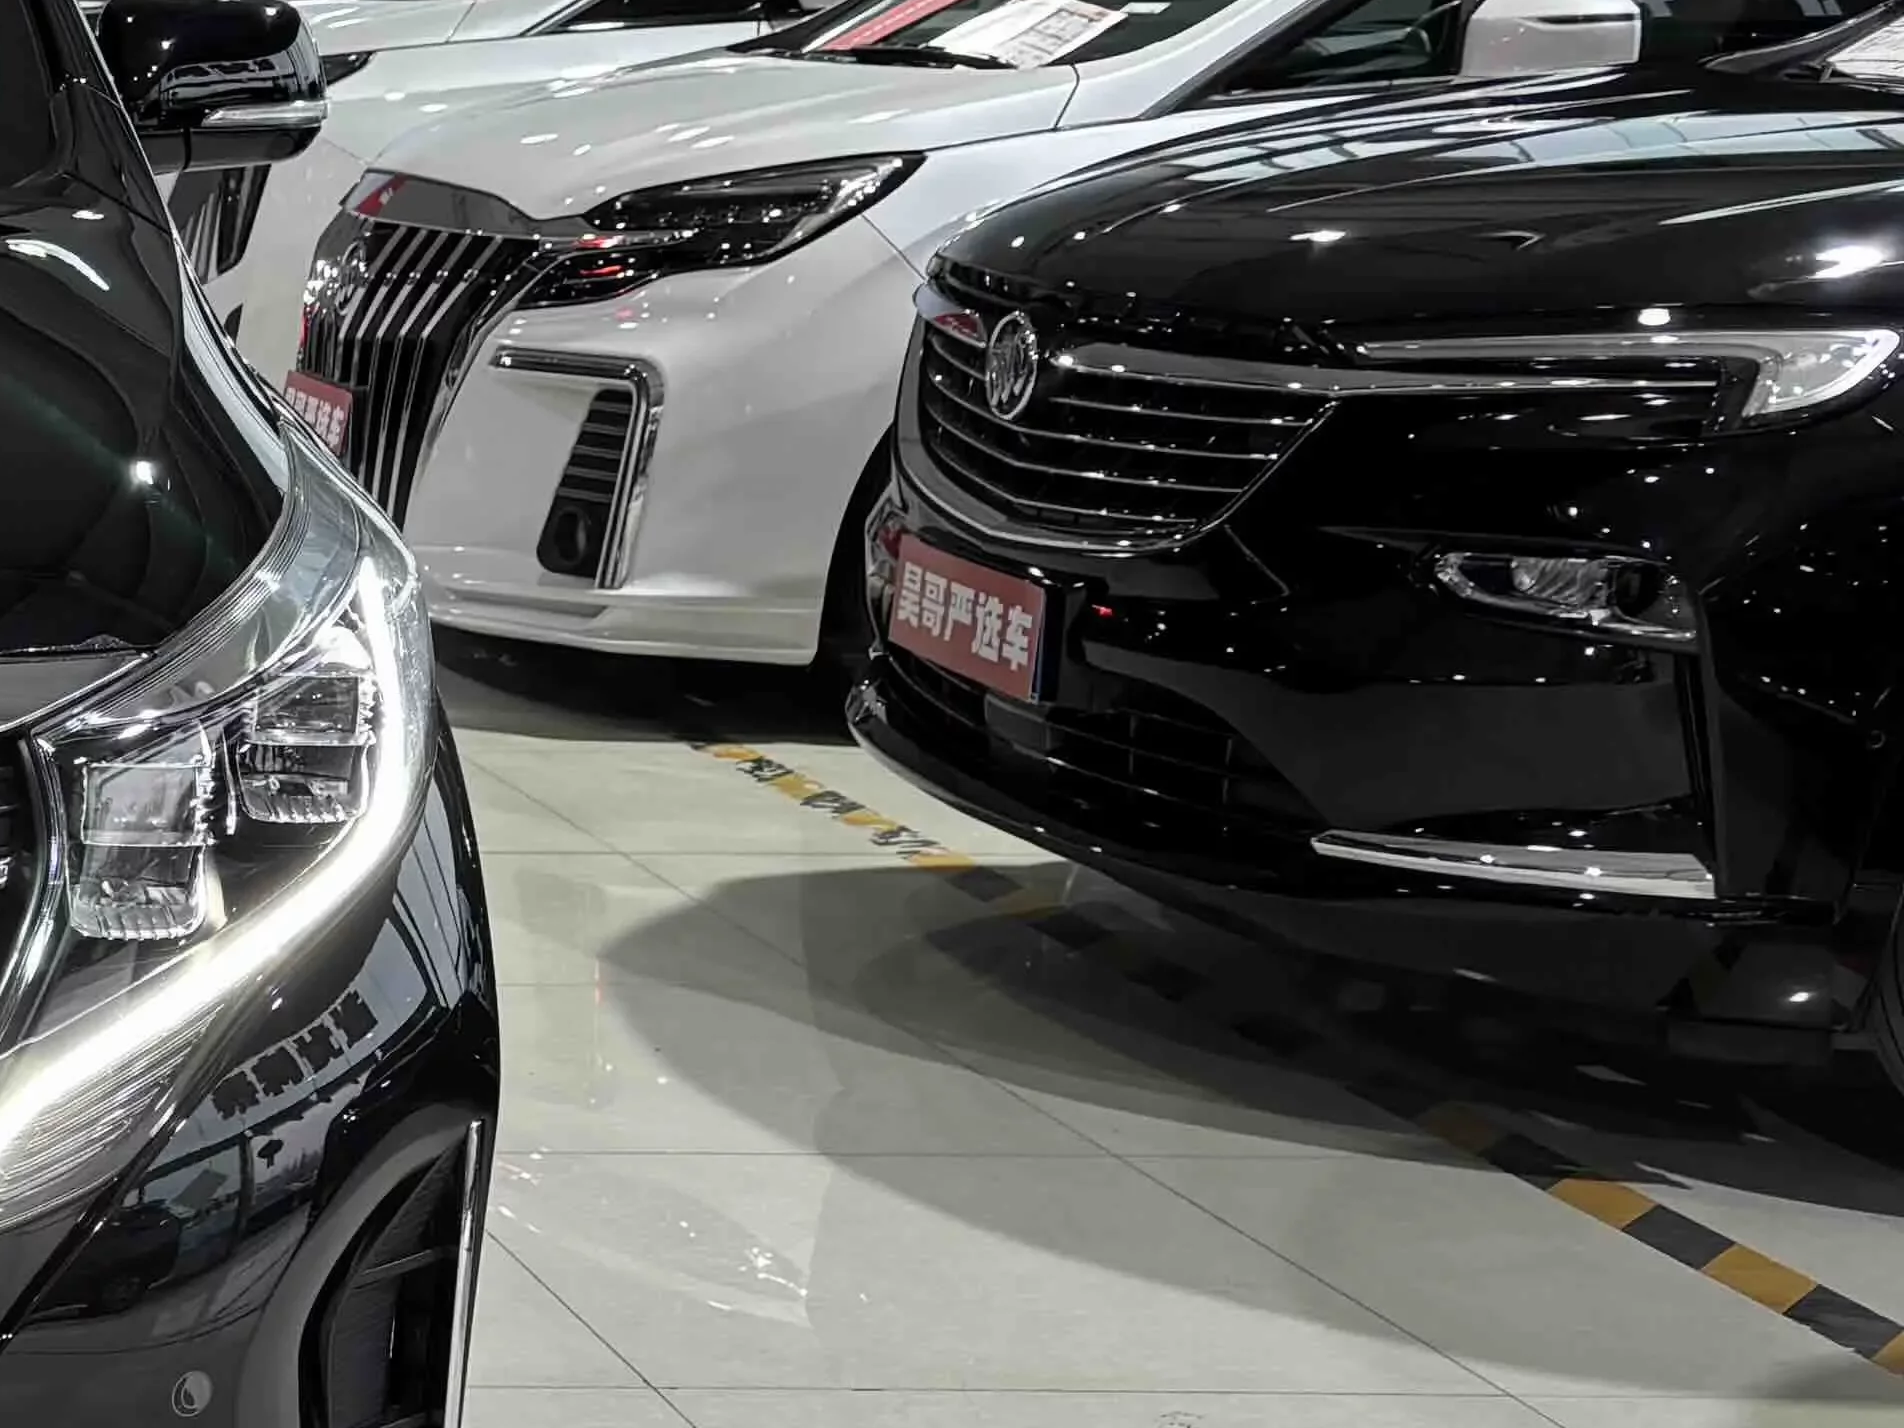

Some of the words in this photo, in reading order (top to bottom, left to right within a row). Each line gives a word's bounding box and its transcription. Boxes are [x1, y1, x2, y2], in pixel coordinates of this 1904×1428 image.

[896, 561, 1033, 671] 昊哥严选车
